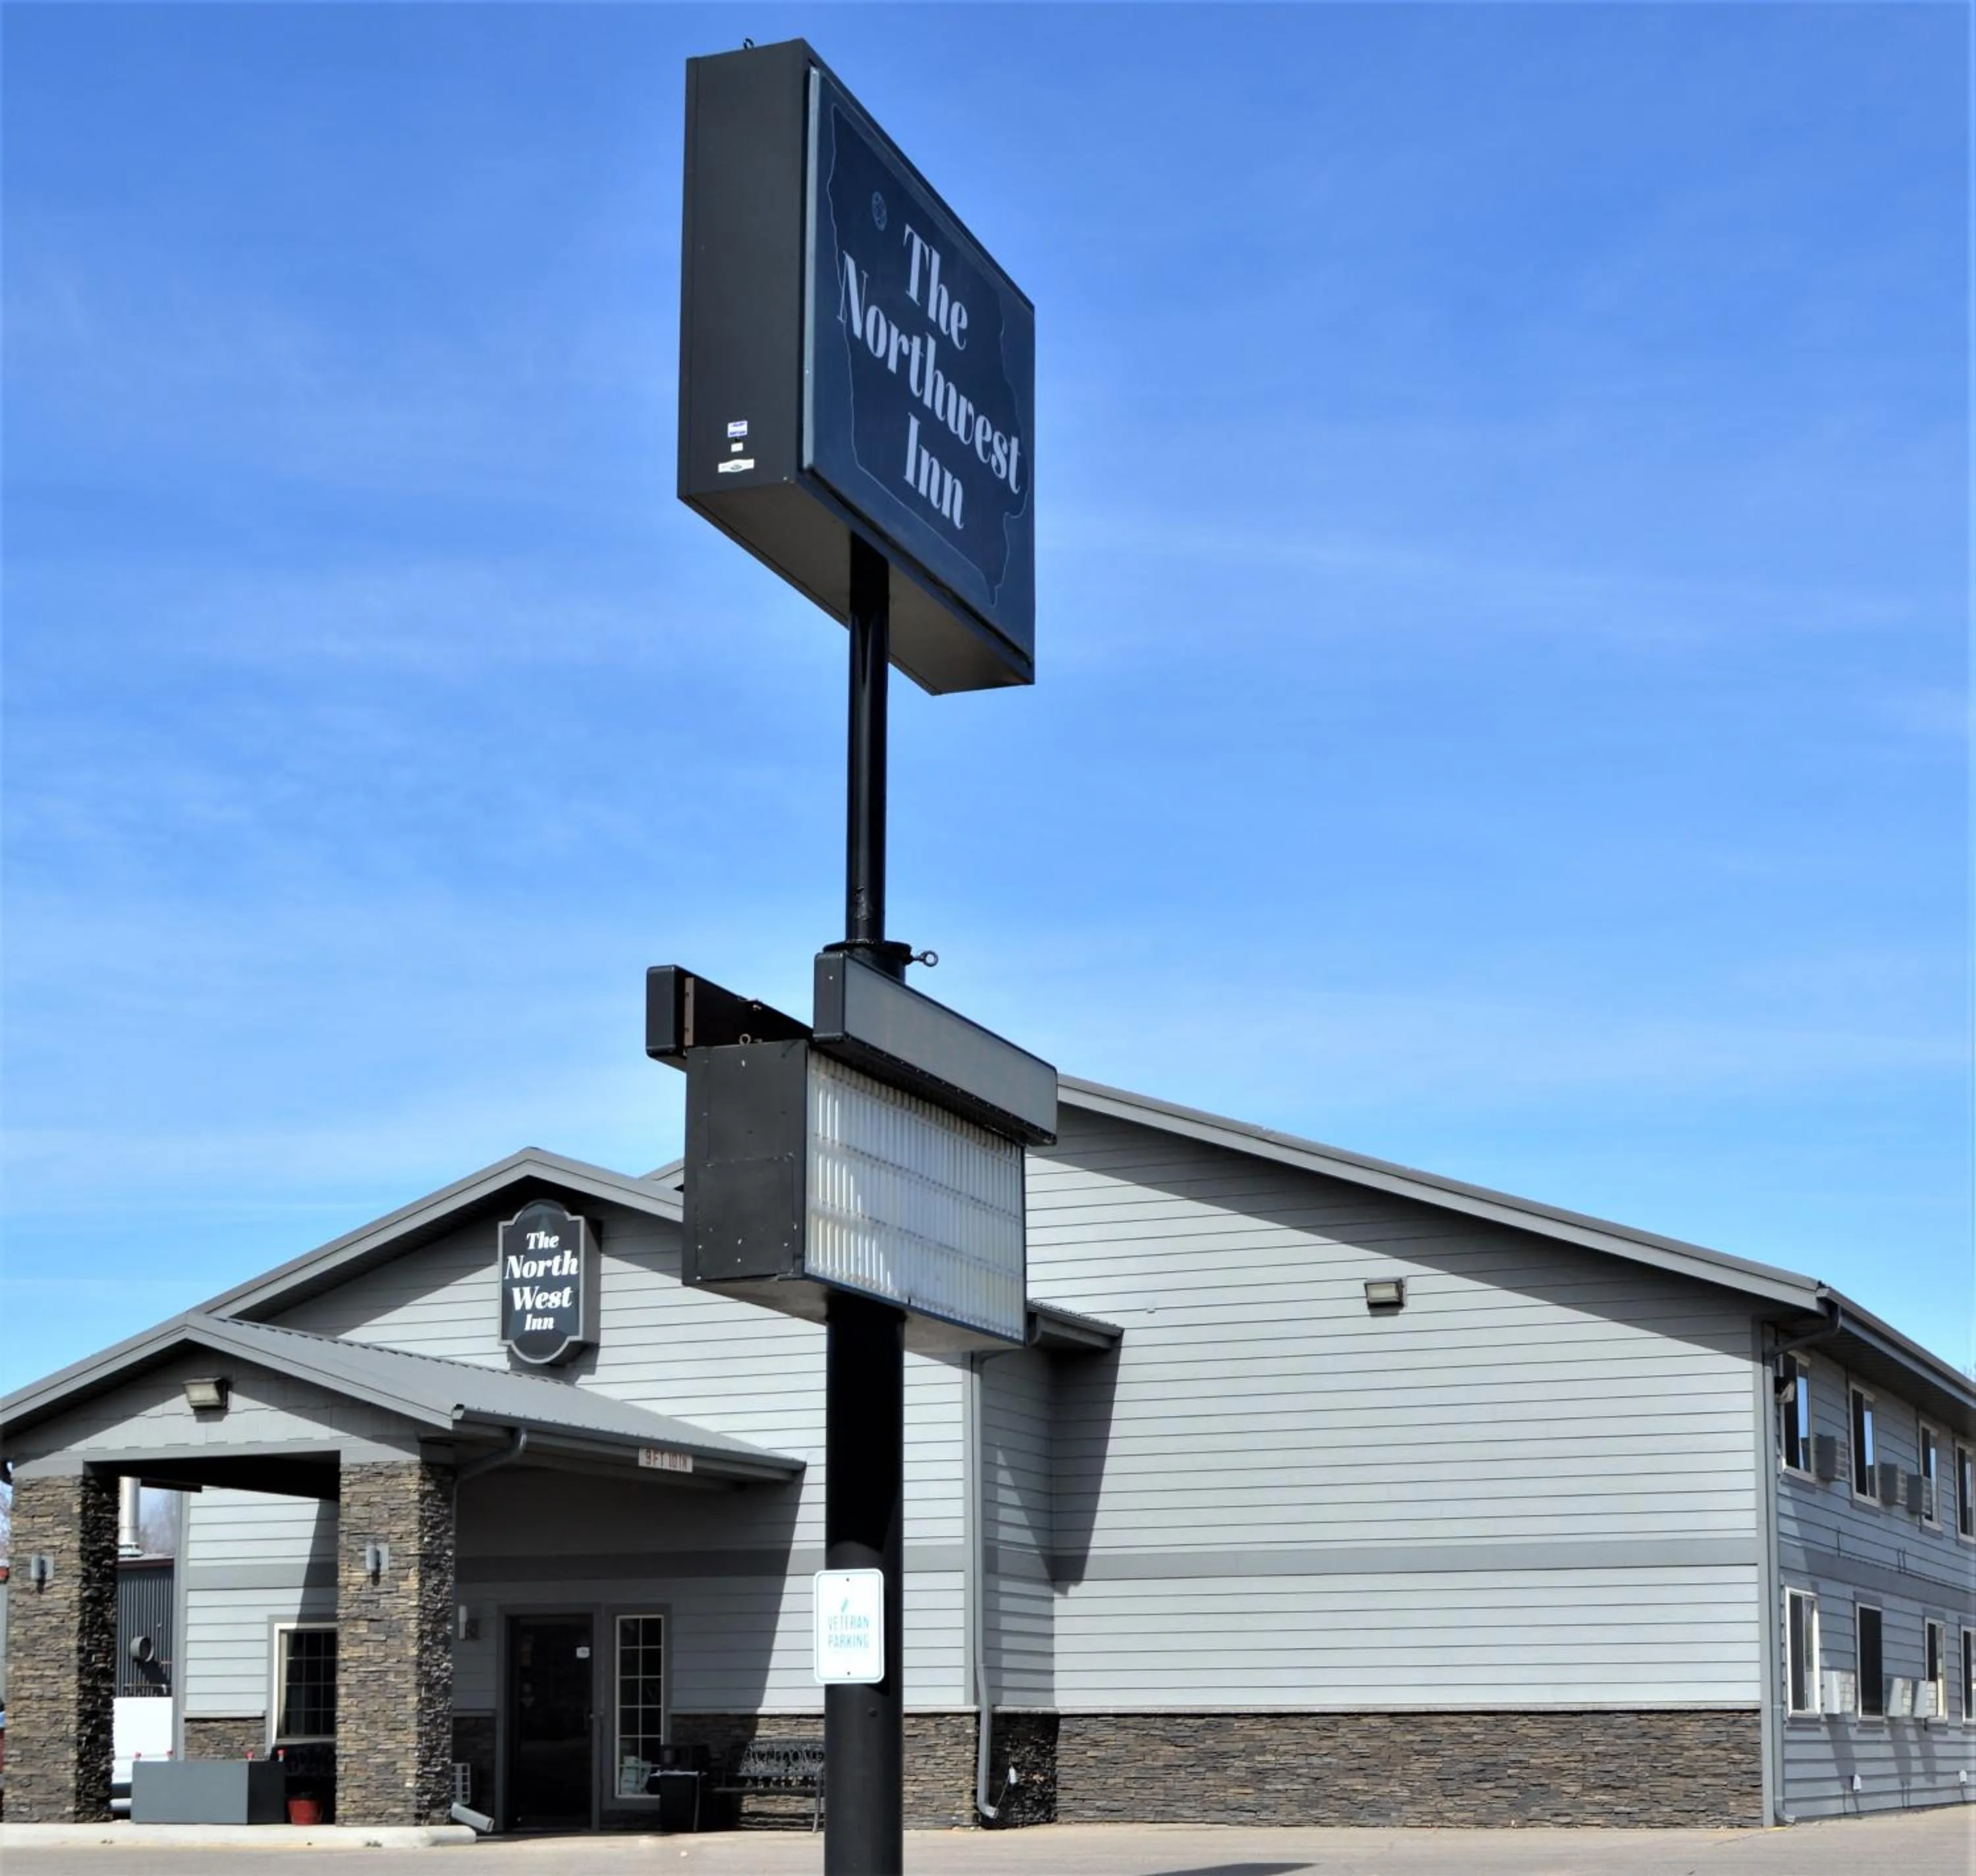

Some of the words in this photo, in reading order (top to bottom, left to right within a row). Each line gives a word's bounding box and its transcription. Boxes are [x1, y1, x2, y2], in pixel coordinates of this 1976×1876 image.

[903, 224, 968, 350] The
[837, 251, 1021, 494] Northwest
[904, 412, 964, 529] Inn
[527, 1231, 559, 1249] The
[504, 1250, 578, 1279] North
[512, 1286, 574, 1310] West
[524, 1314, 554, 1331] Inn
[828, 1615, 869, 1630] VETERAN
[828, 1634, 869, 1648] PARKING
